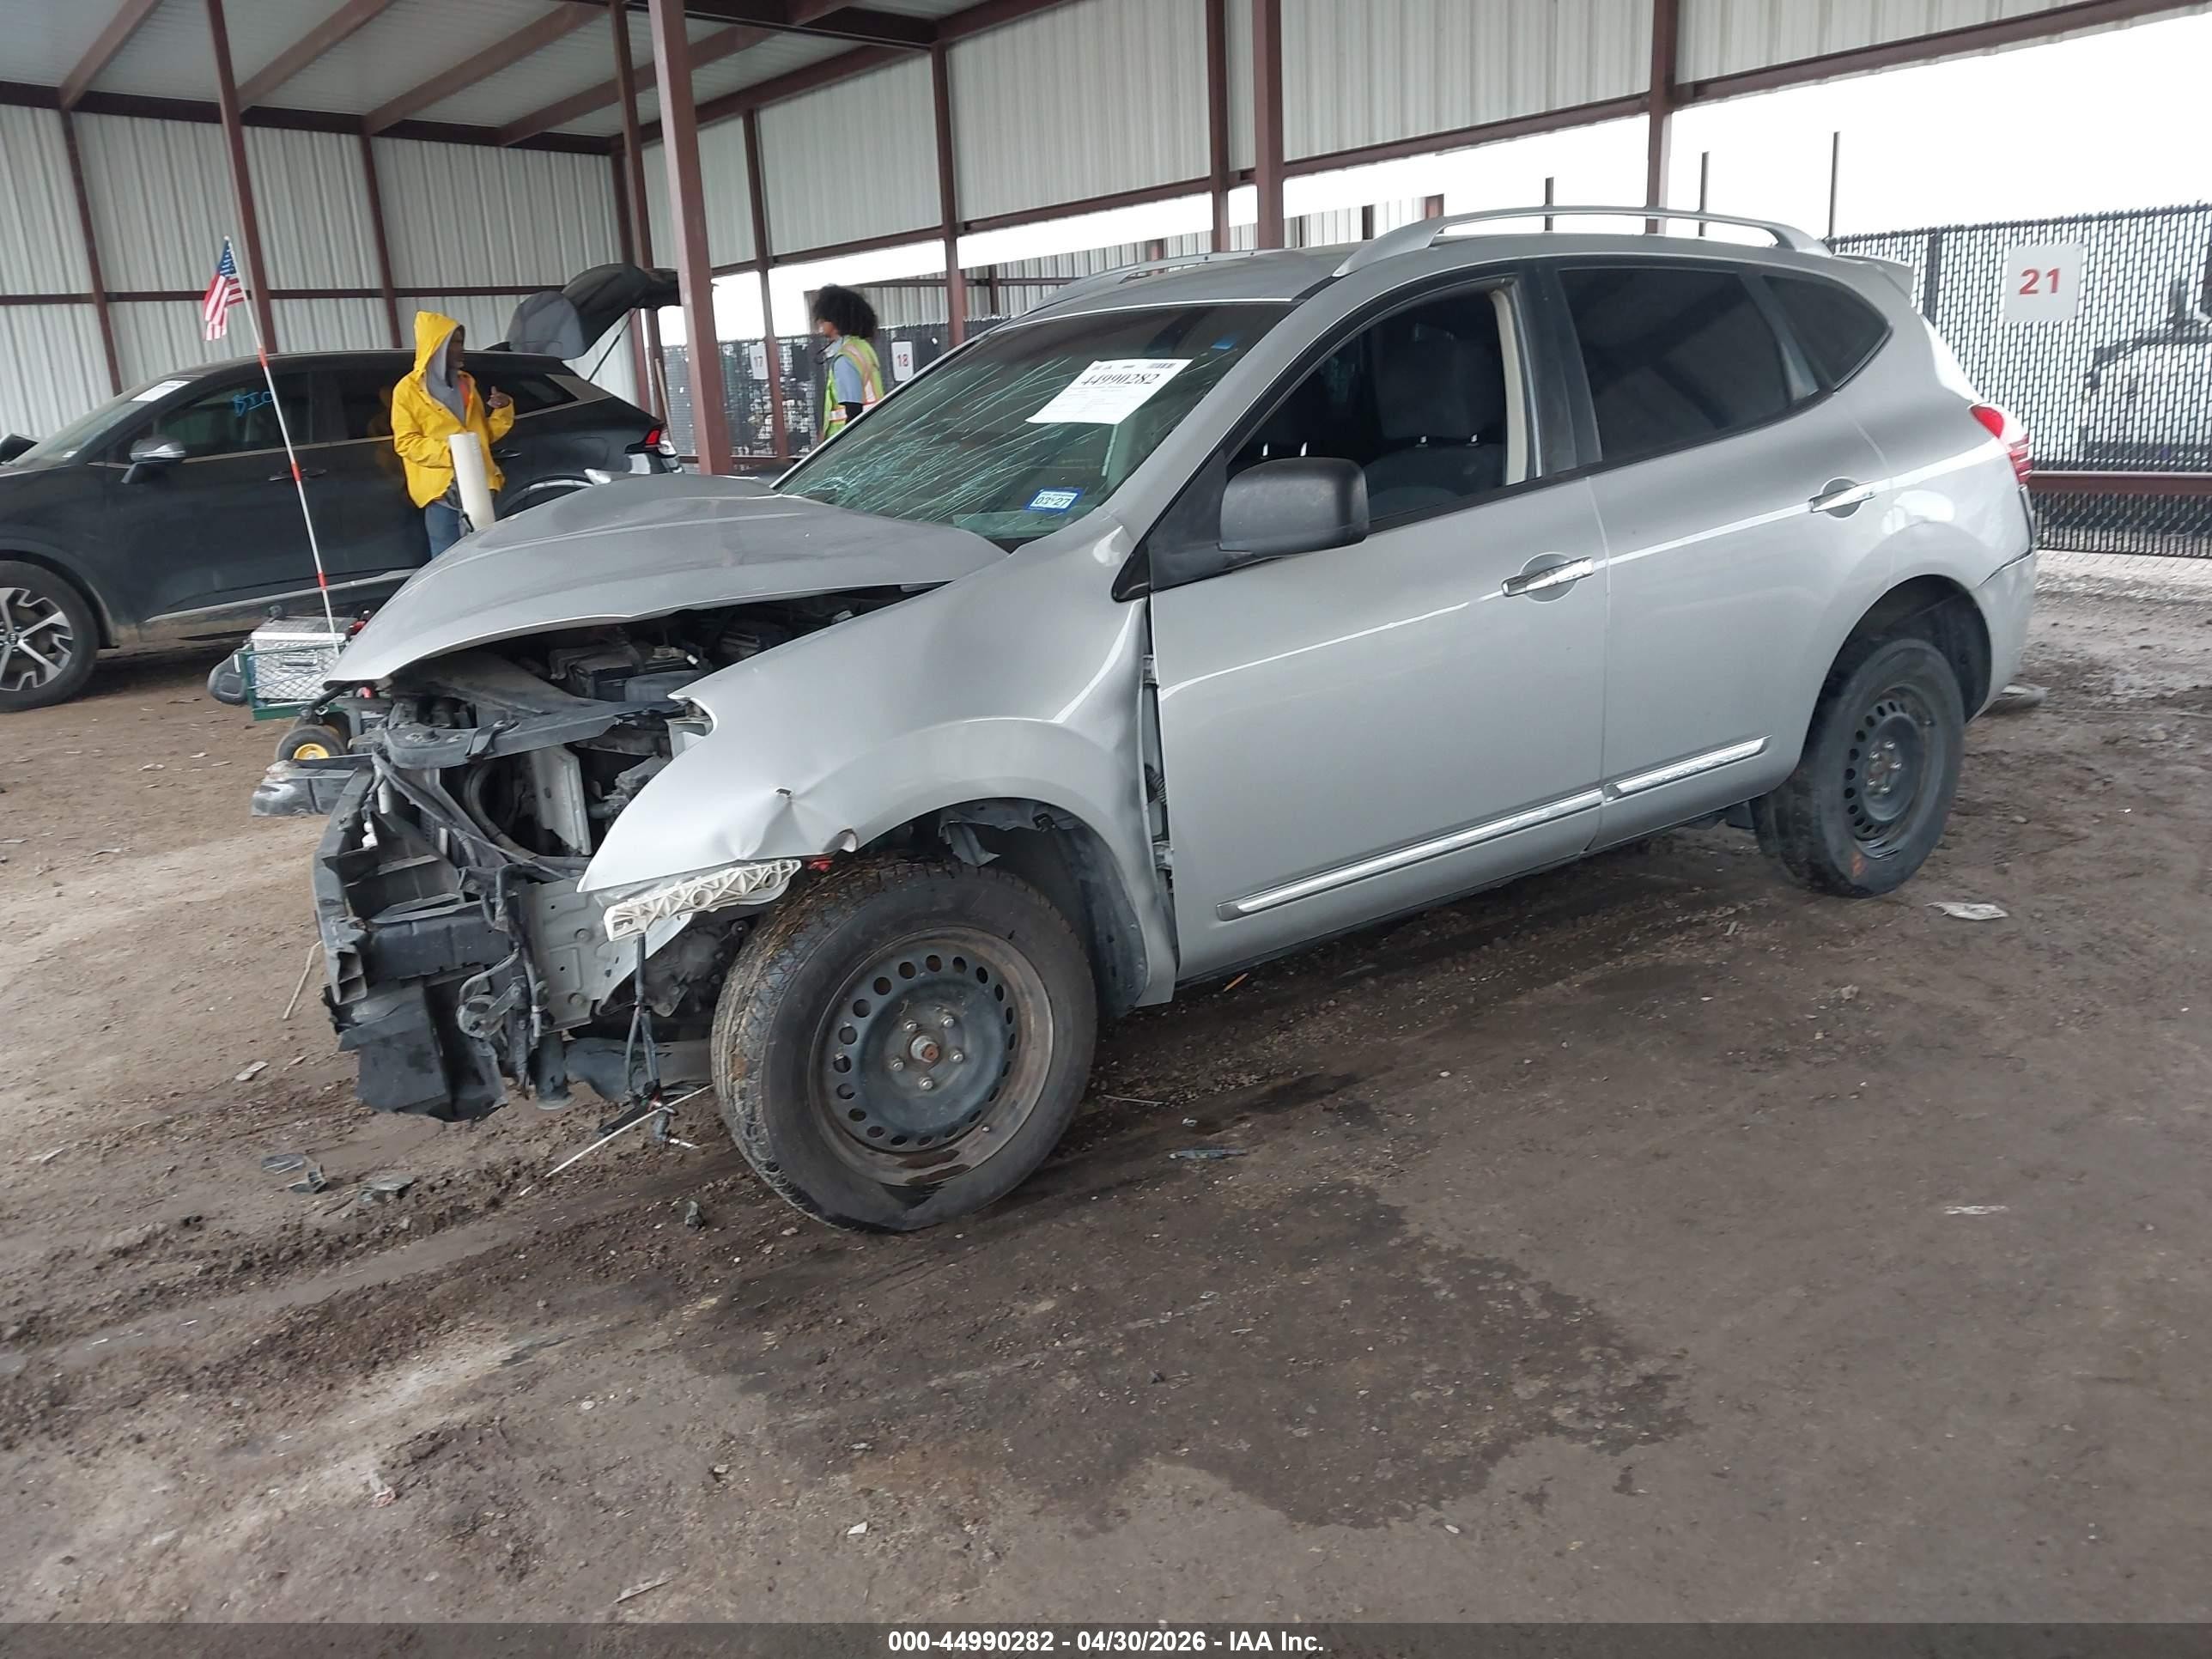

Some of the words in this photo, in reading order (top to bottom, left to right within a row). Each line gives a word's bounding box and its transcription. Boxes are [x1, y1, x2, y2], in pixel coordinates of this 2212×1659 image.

[2019, 267, 2061, 295] 21
[753, 356, 763, 368] 17
[897, 353, 908, 368] 18
[1080, 374, 1161, 386] 44990282
[1053, 497, 1071, 507] 27
